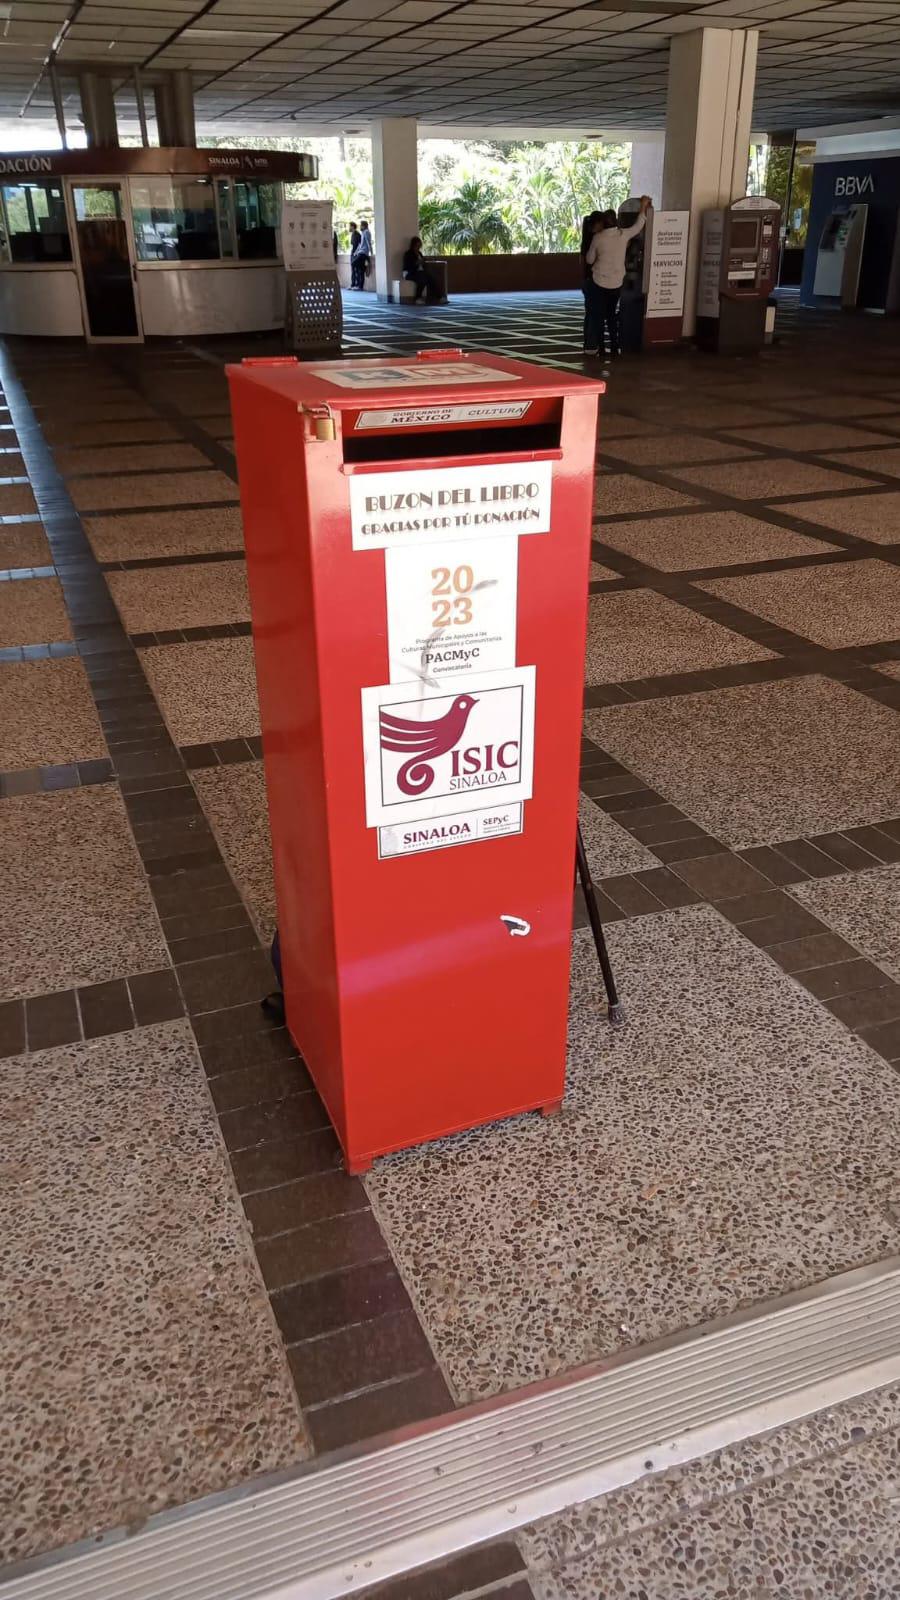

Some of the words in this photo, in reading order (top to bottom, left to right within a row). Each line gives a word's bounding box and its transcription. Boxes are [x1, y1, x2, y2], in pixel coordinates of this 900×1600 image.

[835, 174, 874, 196] BBVA
[390, 413, 451, 424] MÉXICO
[468, 407, 524, 416] CULTURA
[365, 490, 433, 512] BUZON
[438, 488, 476, 506] DEL
[480, 482, 539, 502] LIBRO
[361, 519, 421, 535] GRACIAS
[423, 517, 452, 529] POR
[454, 512, 472, 526] TÚ
[474, 507, 540, 525] DONACIÓN
[431, 565, 474, 596] 20
[431, 597, 473, 628] 23
[425, 647, 480, 664] PACMyC
[451, 740, 519, 777] ISIC
[449, 770, 507, 791] SINALOA
[483, 814, 509, 826] SEPyC
[403, 822, 471, 844] SINALOA
